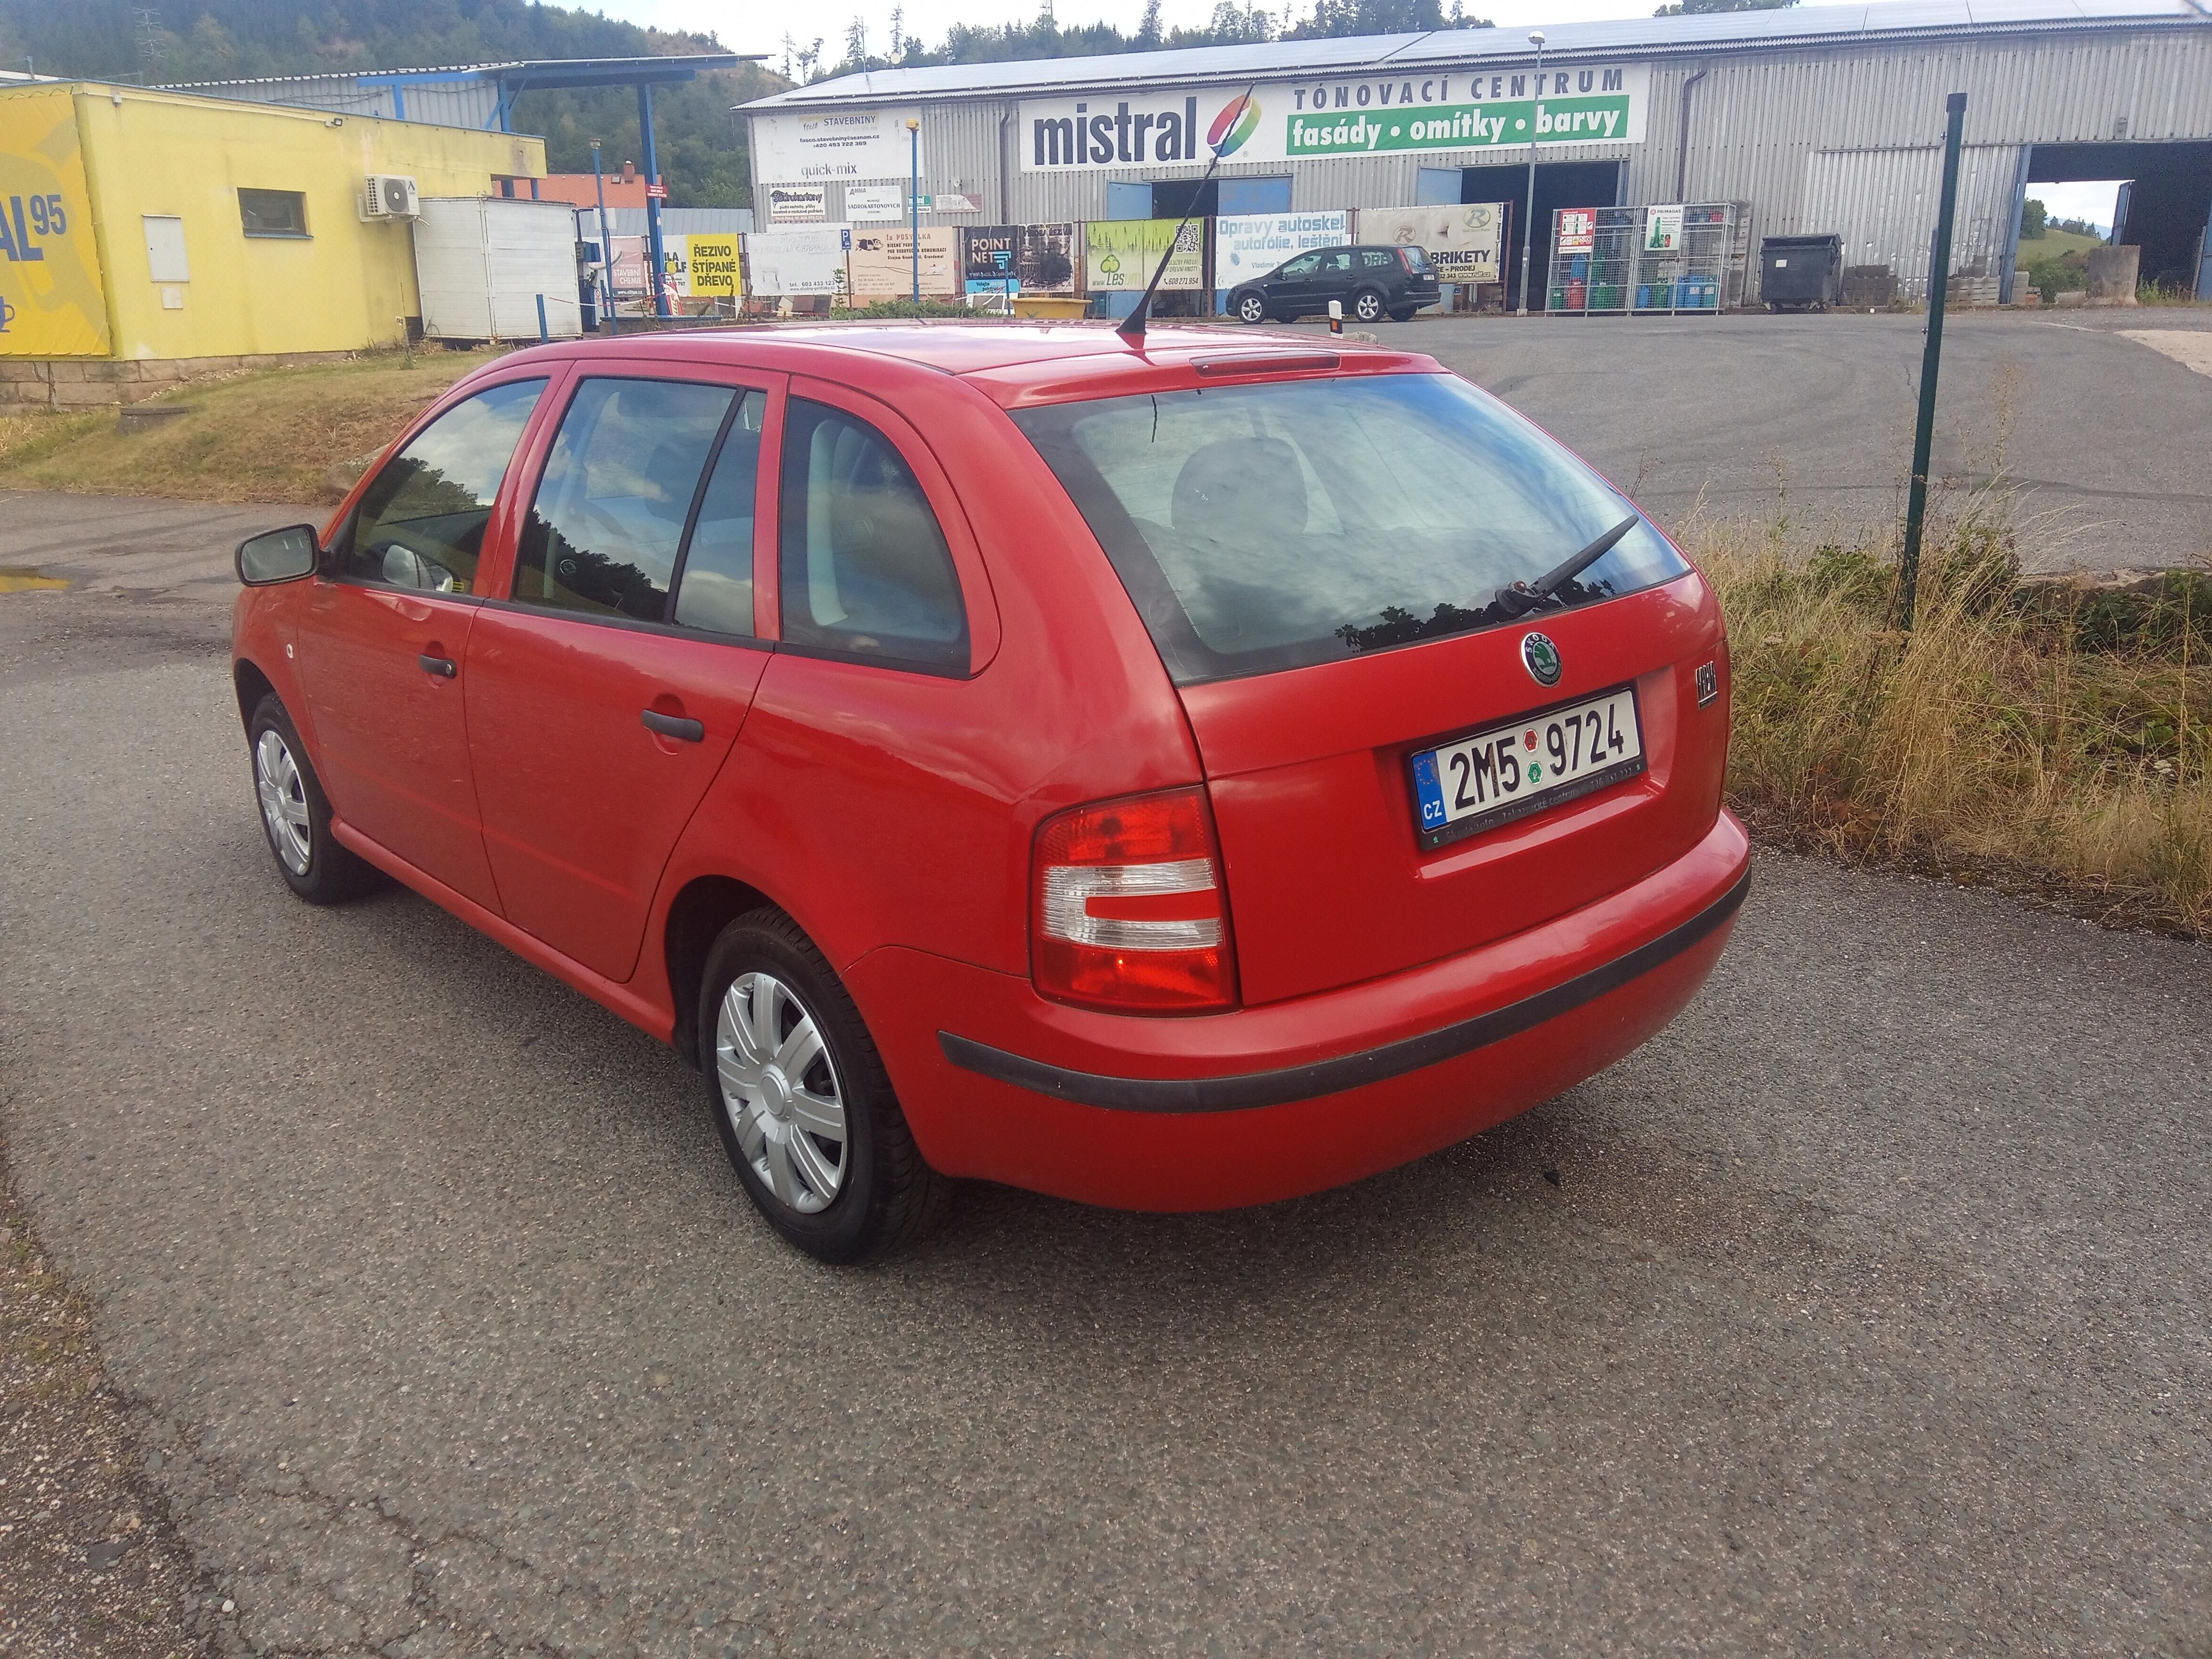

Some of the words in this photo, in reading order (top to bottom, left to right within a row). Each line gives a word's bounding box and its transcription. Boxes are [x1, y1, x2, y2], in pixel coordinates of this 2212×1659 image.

[1294, 75, 1448, 110] TÓNOVACÍ
[1471, 69, 1623, 99] CENTRUM
[824, 115, 876, 126] STAVEBNINY
[1293, 115, 1382, 150] fasády
[1410, 109, 1507, 144] omítky
[1535, 105, 1620, 137] barvy
[1034, 96, 1197, 165] mistral
[801, 162, 857, 179] quick-mix
[30, 194, 66, 235] 95
[1219, 219, 1273, 238] Opravy
[1278, 214, 1344, 232] autoskel
[972, 238, 1011, 251] POINT
[1233, 237, 1293, 251] autofólie,
[1298, 234, 1343, 248] leštění
[664, 252, 679, 261] ILA
[693, 244, 731, 257] ŘEZIVO
[972, 252, 994, 264] NET
[1431, 250, 1491, 264] BRIKETY
[613, 267, 641, 276] STAVEBNÍ
[692, 259, 736, 273] ŠTÍPANÉ
[697, 273, 733, 286] DŘEVO
[1449, 736, 1520, 810] 2M5
[1546, 704, 1624, 776] 9724
[1424, 800, 1442, 820] CZ
